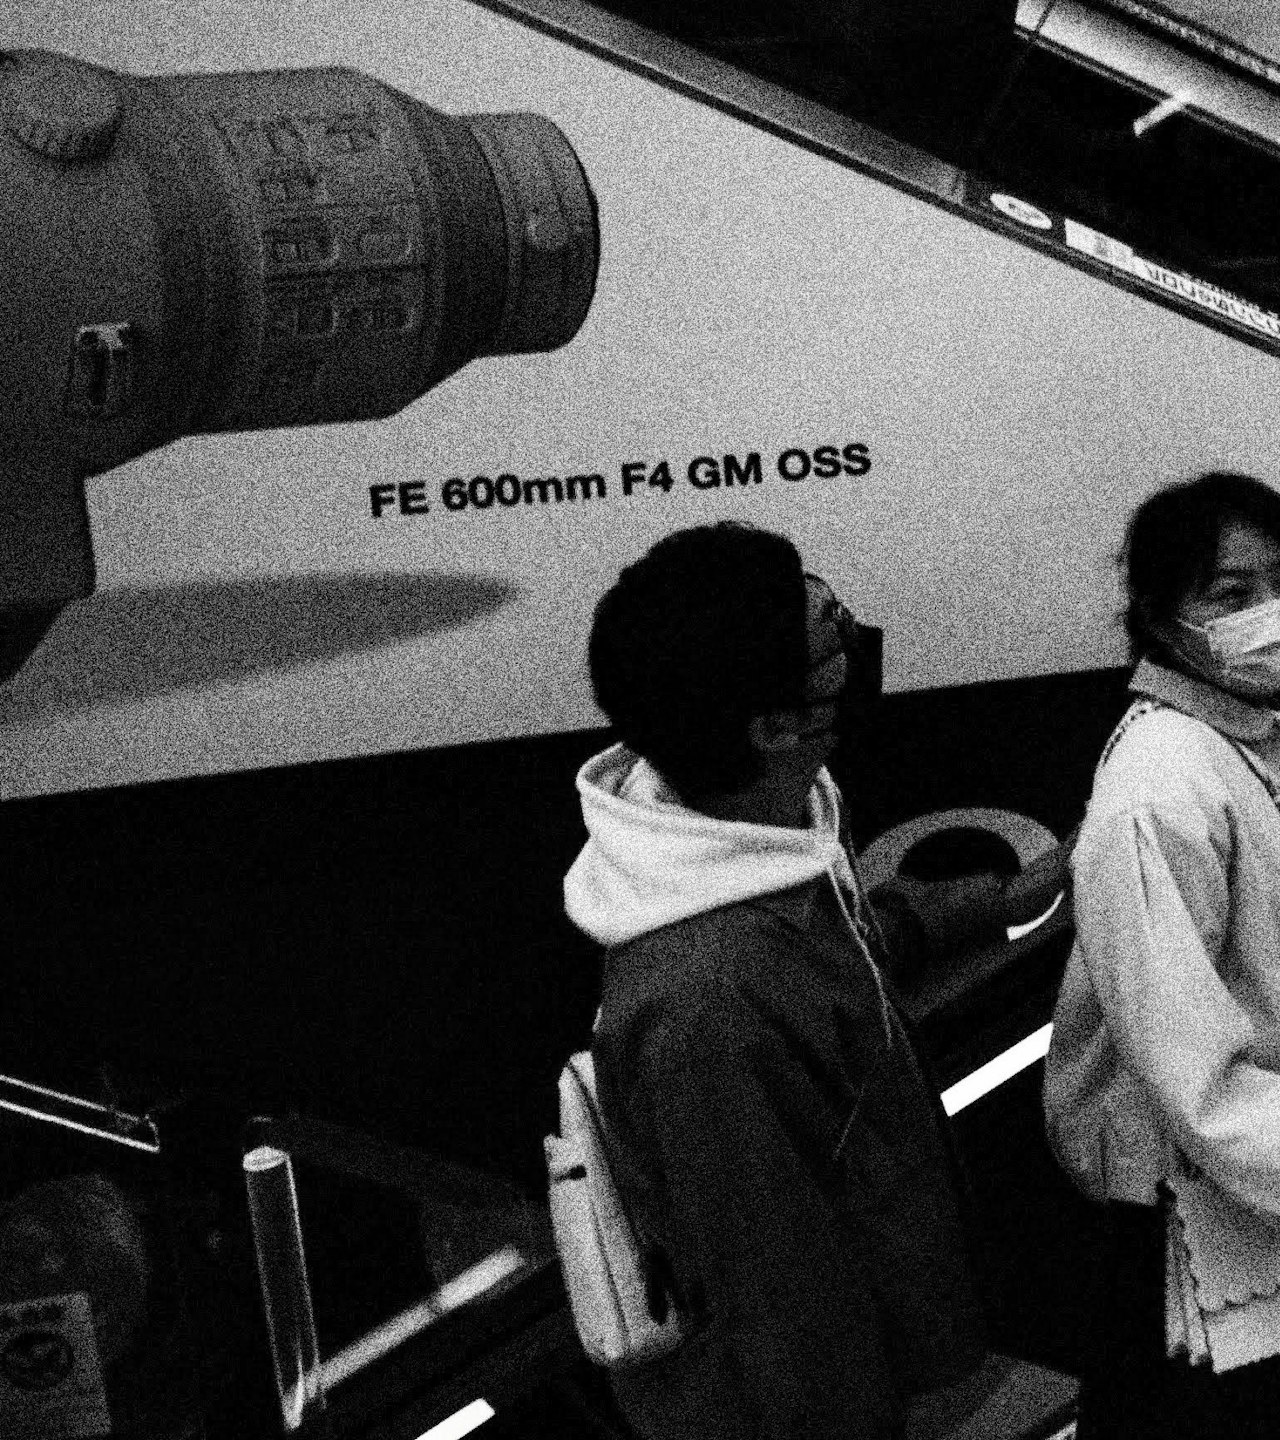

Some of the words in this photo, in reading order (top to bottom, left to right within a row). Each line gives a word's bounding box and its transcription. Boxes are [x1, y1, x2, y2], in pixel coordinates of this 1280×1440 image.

[370, 480, 430, 519] FE
[441, 470, 607, 514] 600mm
[620, 457, 674, 498] F4
[687, 449, 764, 490] GM
[777, 441, 872, 482] OSS
